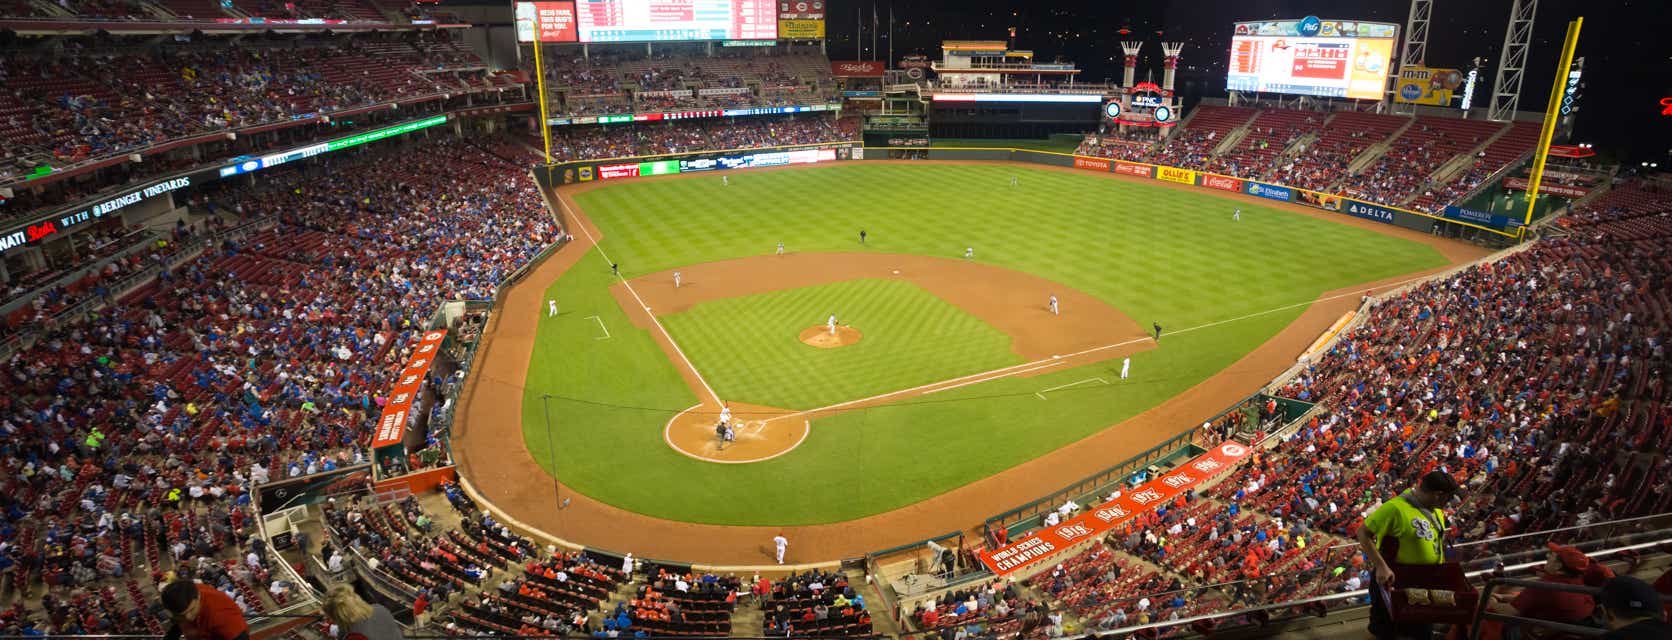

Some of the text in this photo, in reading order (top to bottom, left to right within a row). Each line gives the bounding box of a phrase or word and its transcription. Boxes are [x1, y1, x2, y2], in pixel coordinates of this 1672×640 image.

[1302, 22, 1319, 32] P&G
[1085, 160, 1108, 169] TOYOTA
[0, 231, 26, 251] NATI
[60, 210, 89, 227] WITH
[100, 191, 142, 214] BERINGER
[143, 176, 190, 199] VINEYARDS
[1360, 206, 1393, 220] DELTA
[1132, 490, 1160, 505] 1975
[1058, 525, 1088, 539] 1919
[991, 537, 1043, 562] WORLD SERIES
[996, 541, 1055, 571] CHAMPIONS
